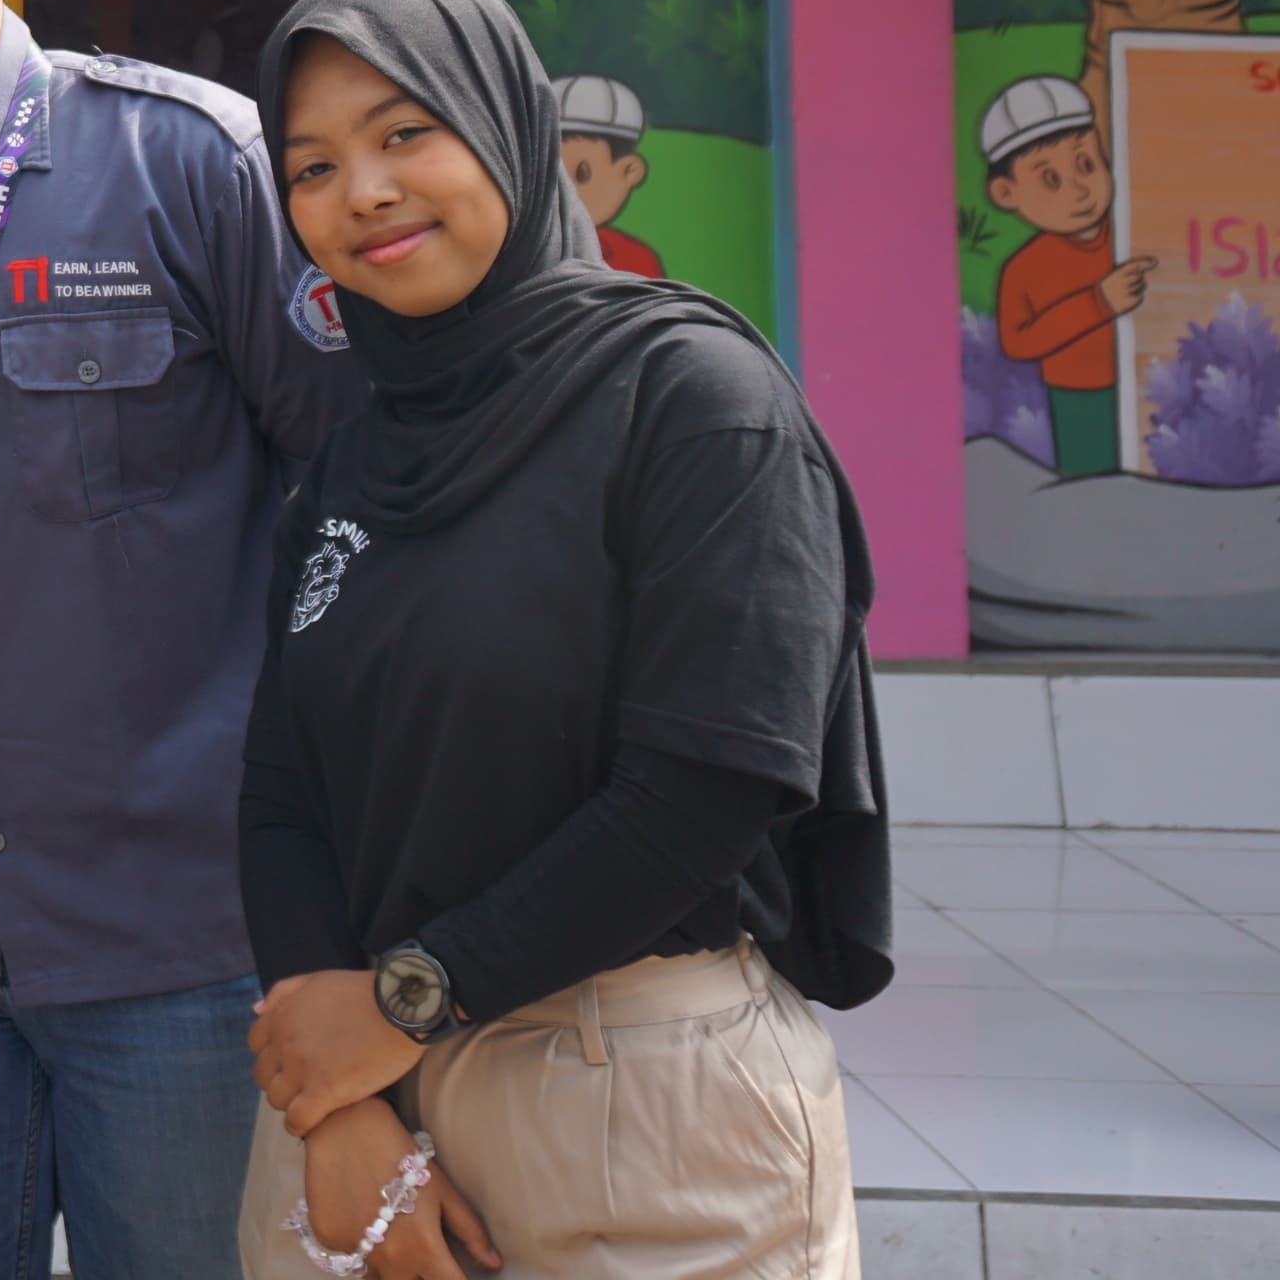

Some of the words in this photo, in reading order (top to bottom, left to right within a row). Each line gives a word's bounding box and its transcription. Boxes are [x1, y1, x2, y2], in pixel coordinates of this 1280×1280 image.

[1249, 60, 1280, 94] S
[54, 262, 92, 276] EARN,
[95, 261, 140, 275] LEARN,
[55, 284, 72, 297] TO
